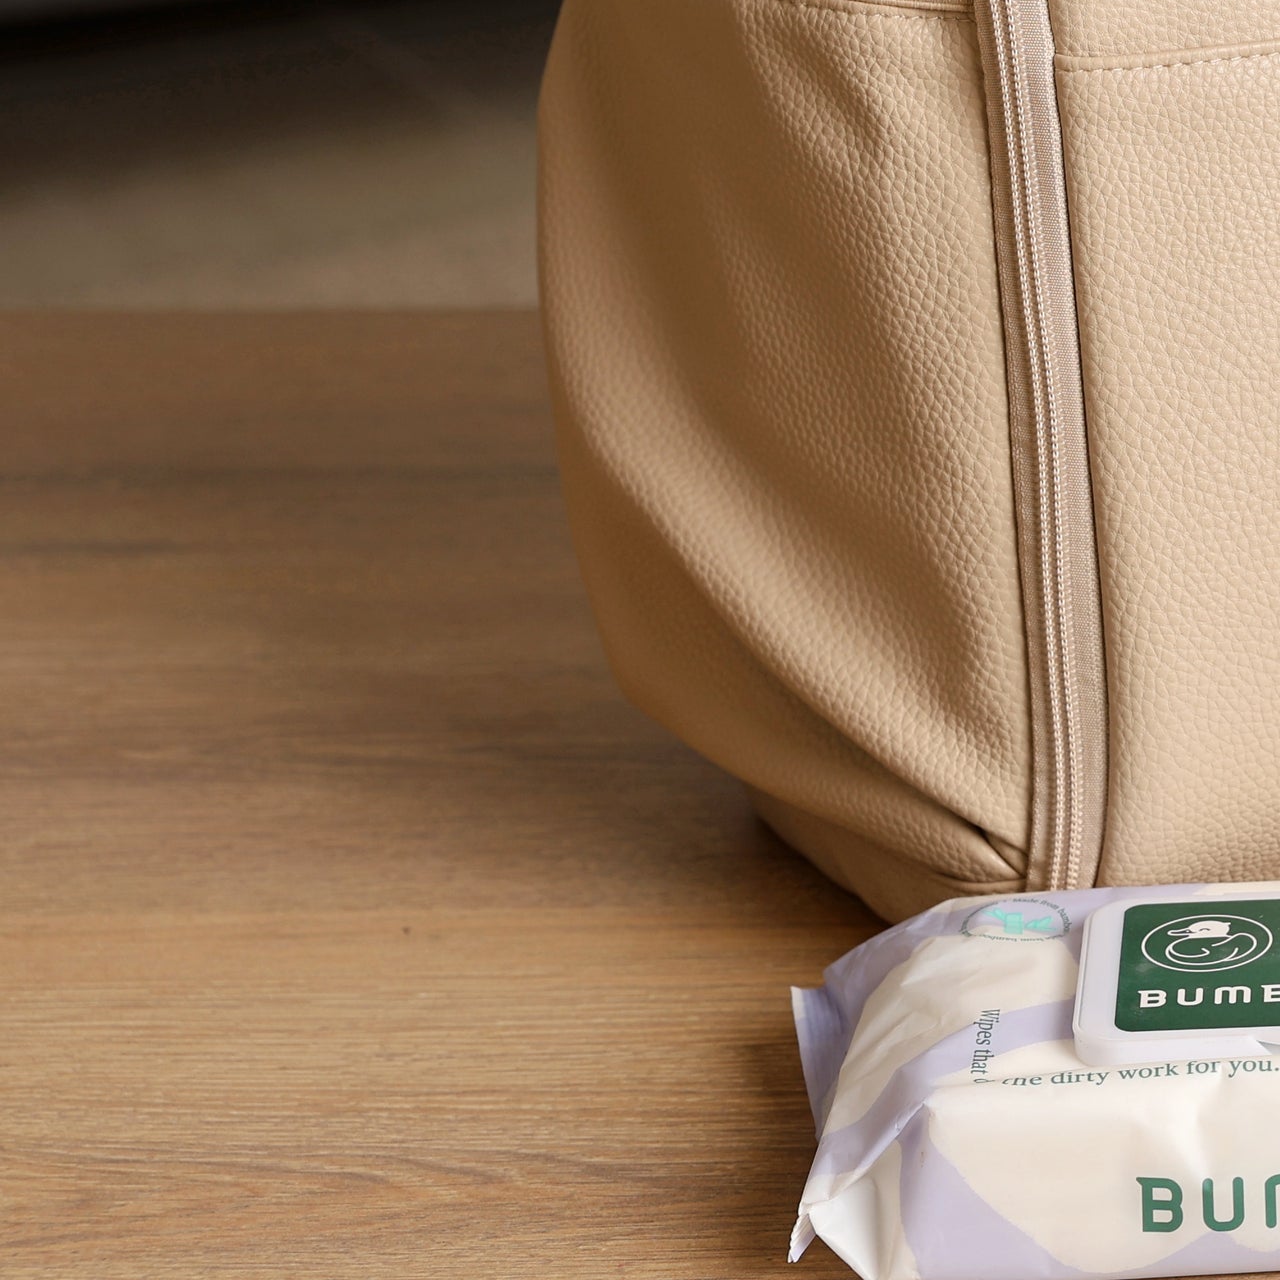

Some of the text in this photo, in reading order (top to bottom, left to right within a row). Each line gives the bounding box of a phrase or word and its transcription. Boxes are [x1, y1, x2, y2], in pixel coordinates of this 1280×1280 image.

[974, 1008, 1001, 1046] Wipes
[970, 1048, 996, 1076] that
[1186, 1059, 1222, 1074] for
[1228, 1059, 1280, 1078] you.
[1050, 1071, 1110, 1086] dirty
[1118, 1063, 1180, 1080] work
